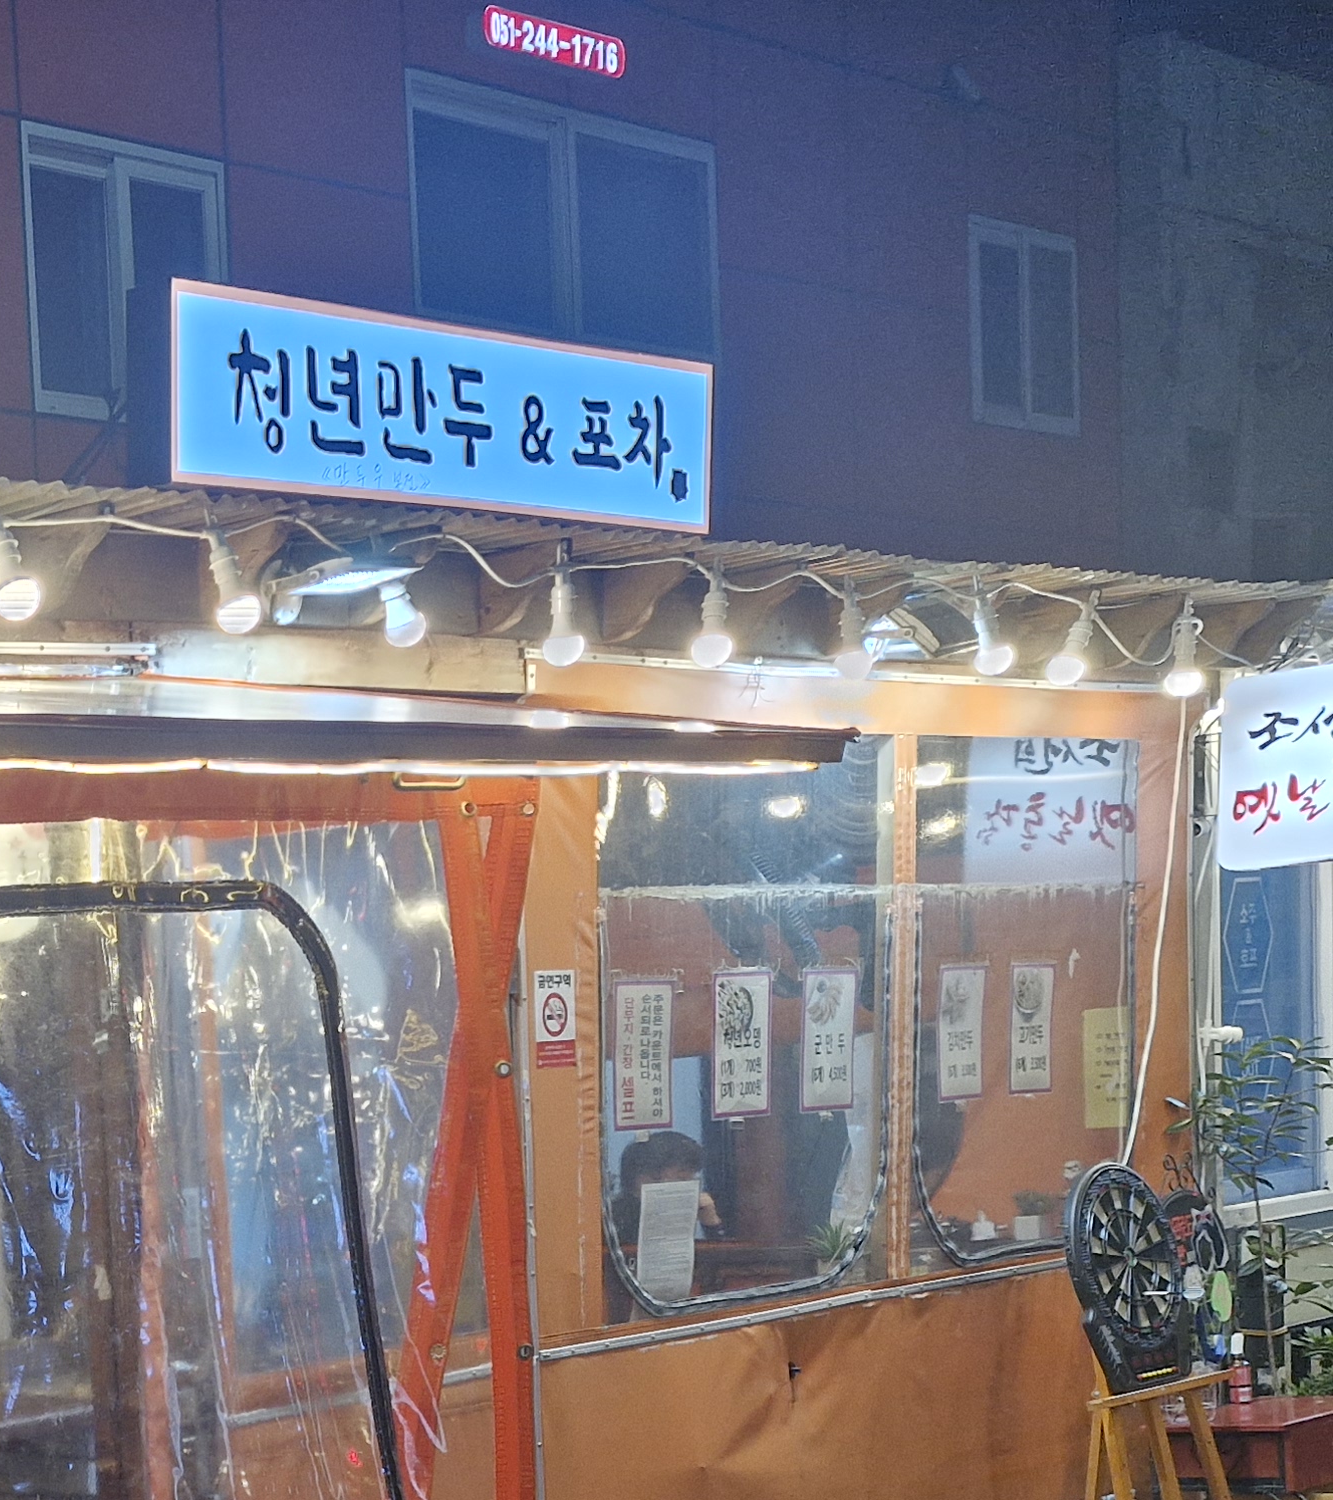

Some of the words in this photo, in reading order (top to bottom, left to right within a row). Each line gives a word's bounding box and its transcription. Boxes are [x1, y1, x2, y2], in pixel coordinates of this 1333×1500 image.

[490, 11, 618, 73] 051-244-1716
[227, 328, 493, 468] 청년만두
[523, 396, 555, 466] &
[572, 396, 673, 490] 포차
[538, 974, 572, 989] 금연구역
[814, 1033, 846, 1055] 군만두
